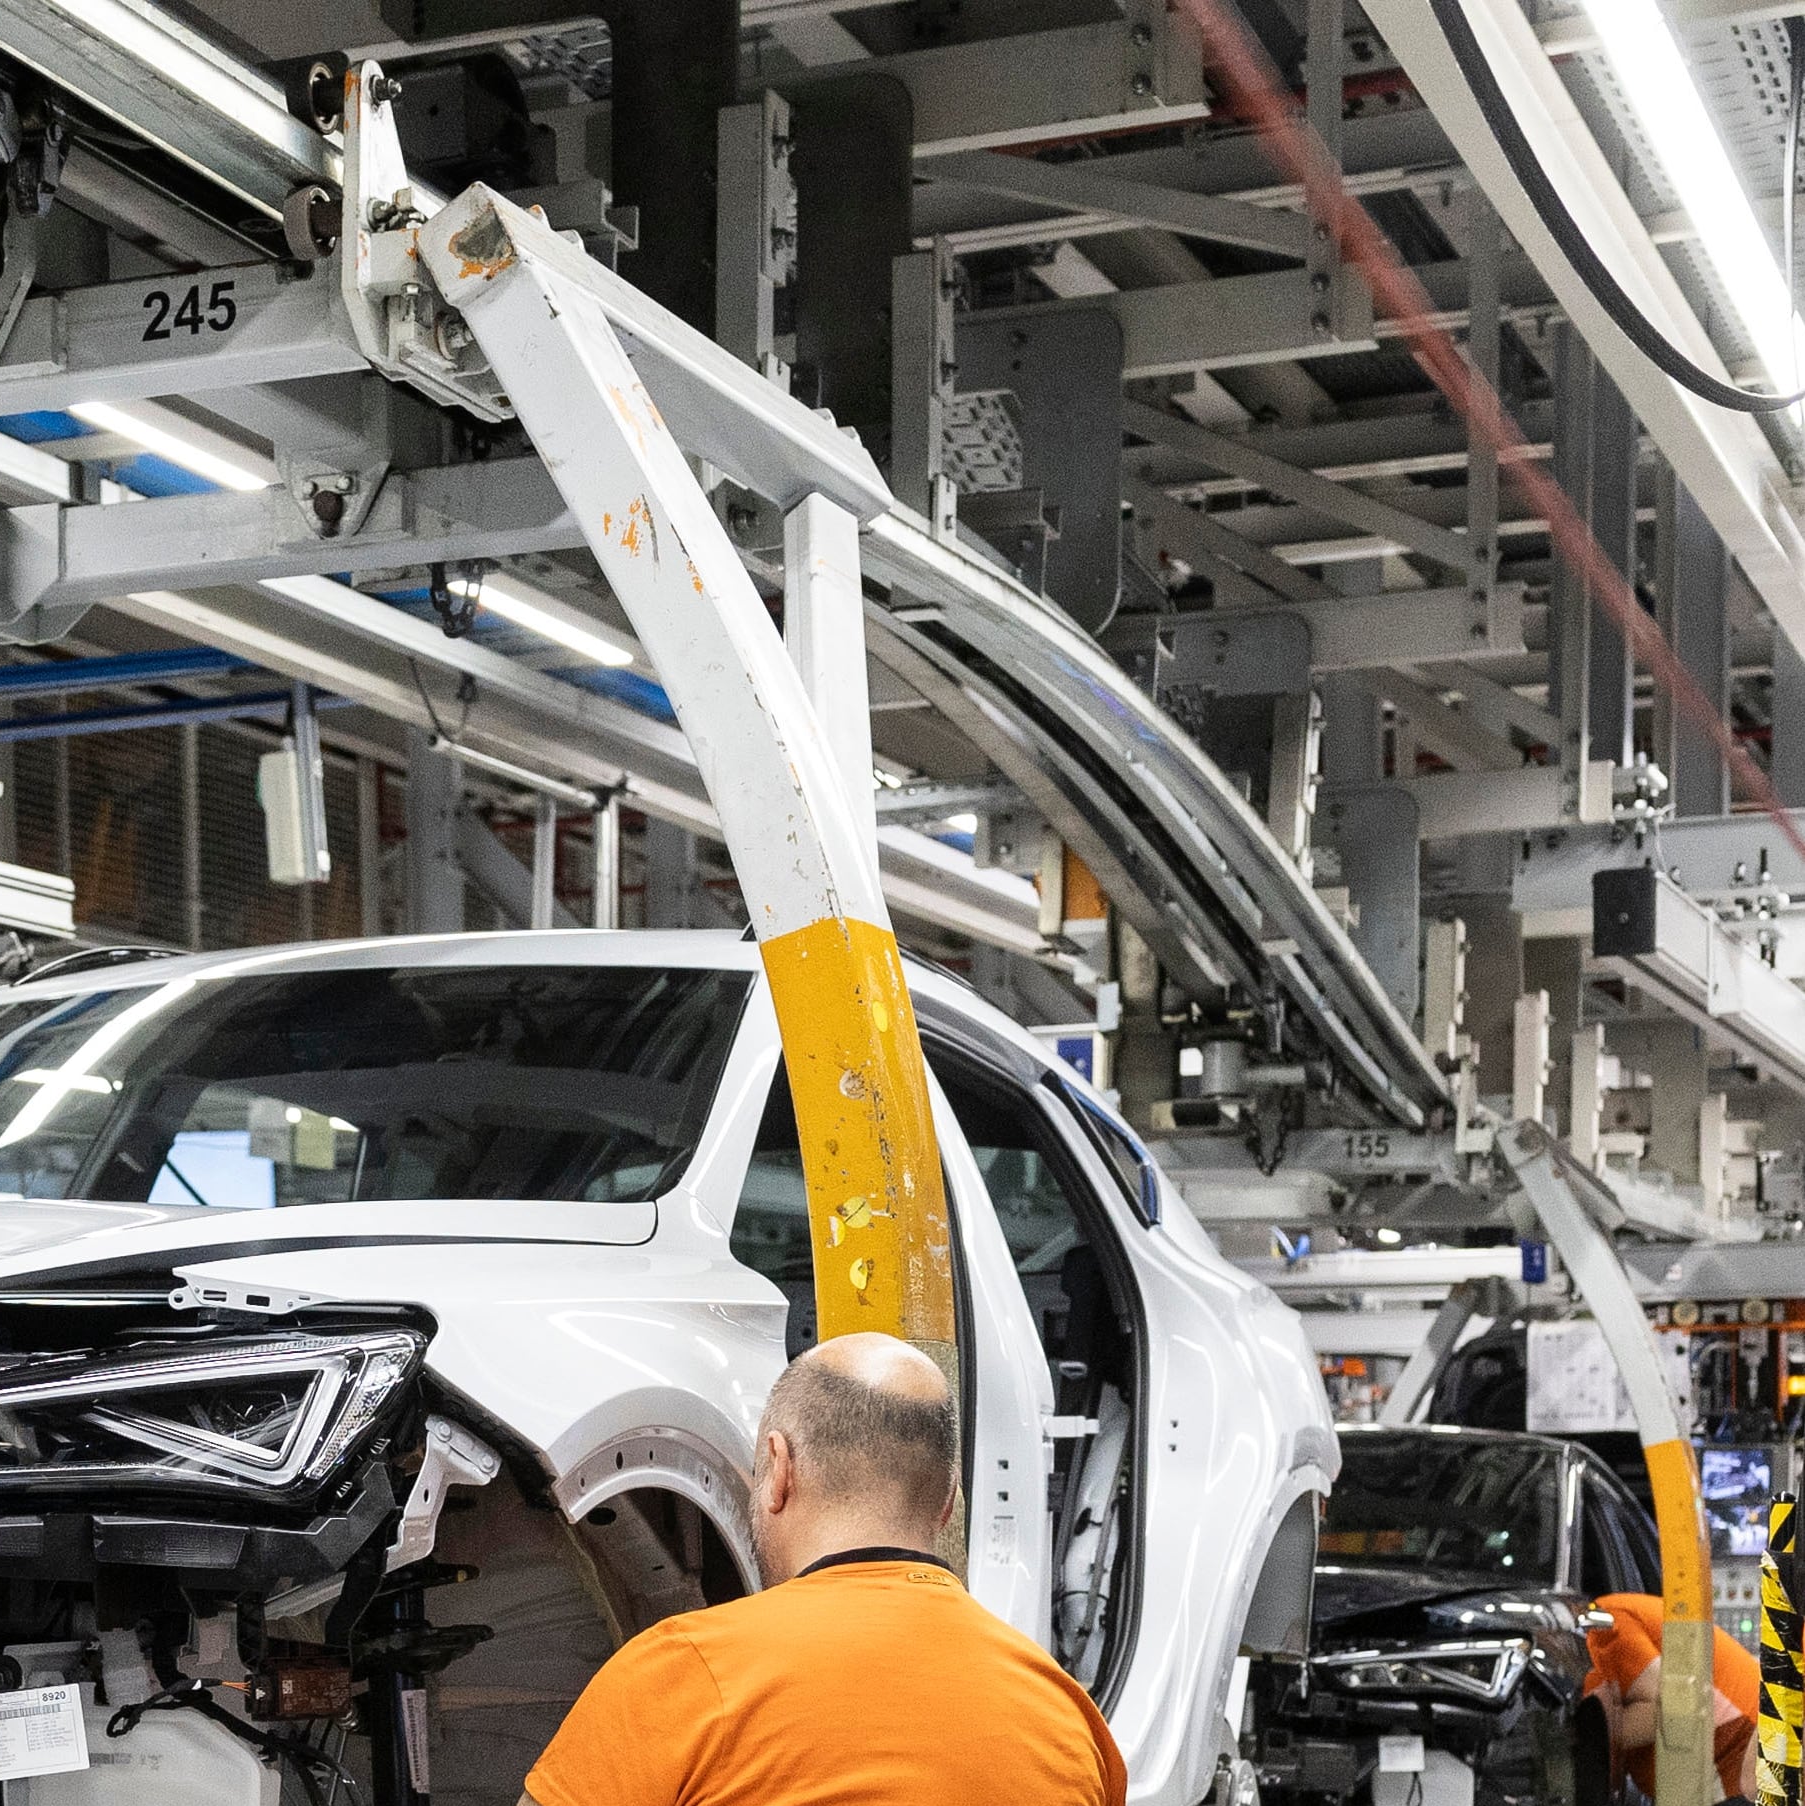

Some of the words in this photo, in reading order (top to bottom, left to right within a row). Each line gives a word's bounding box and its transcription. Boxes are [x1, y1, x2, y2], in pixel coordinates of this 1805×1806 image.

[143, 281, 236, 342] 245
[1346, 1135, 1389, 1158] 155
[42, 1690, 66, 1702] 8920
